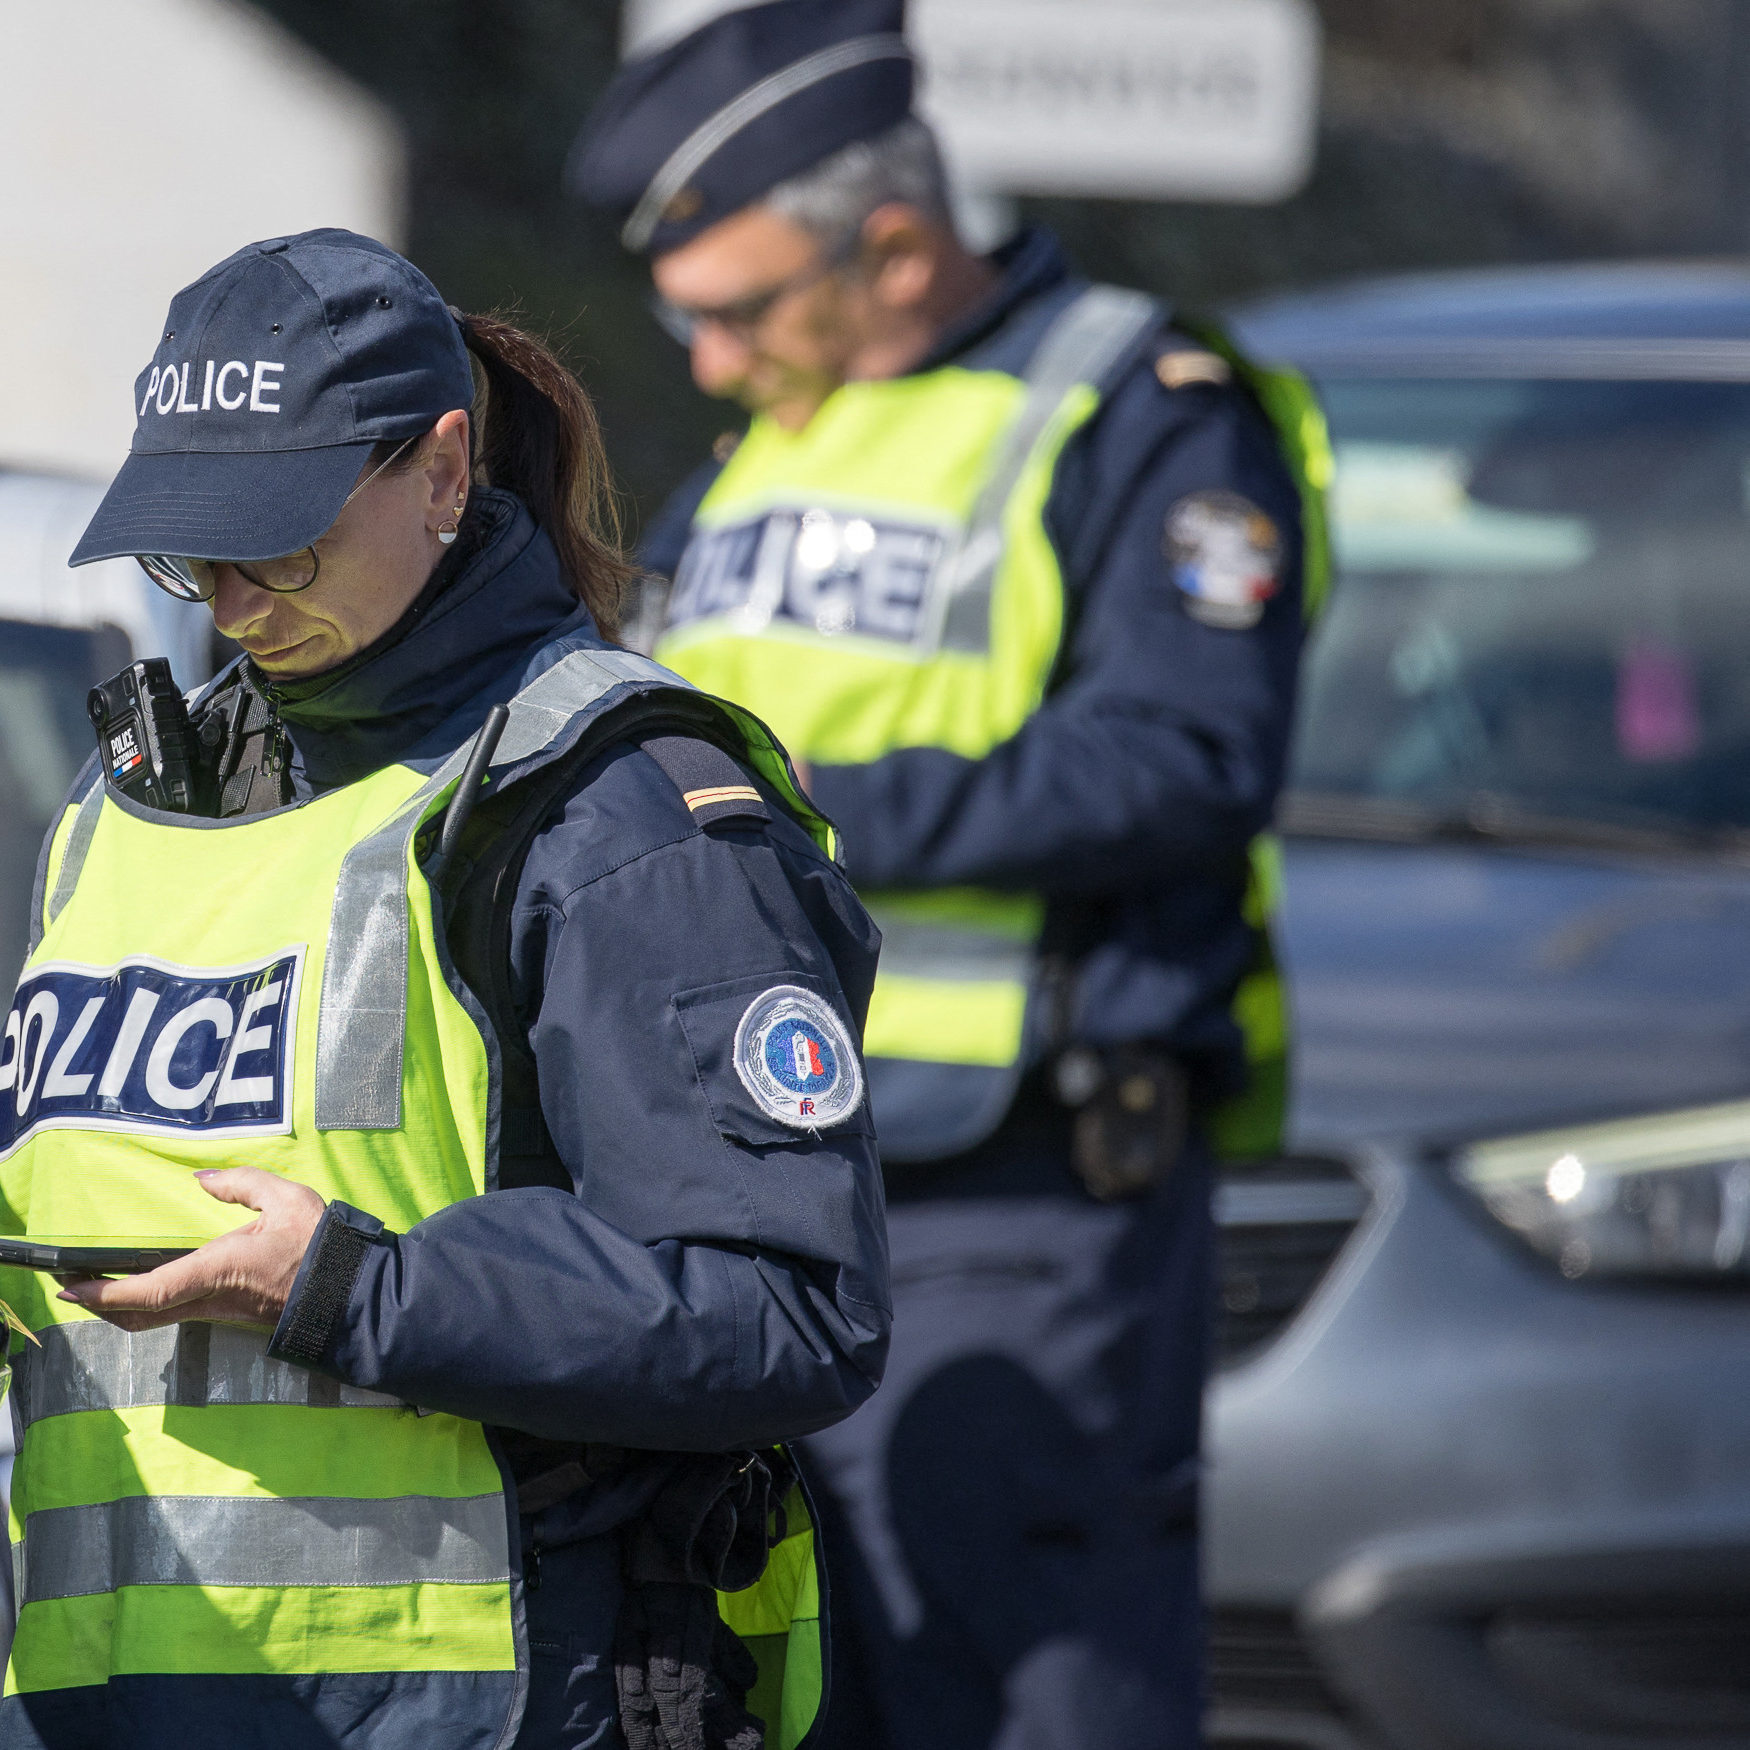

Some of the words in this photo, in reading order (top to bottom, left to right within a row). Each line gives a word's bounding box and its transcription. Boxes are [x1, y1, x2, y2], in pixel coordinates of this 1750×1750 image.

[139, 360, 285, 417] POLICE
[110, 727, 135, 758] POLICE
[112, 744, 139, 770] NATIONALE
